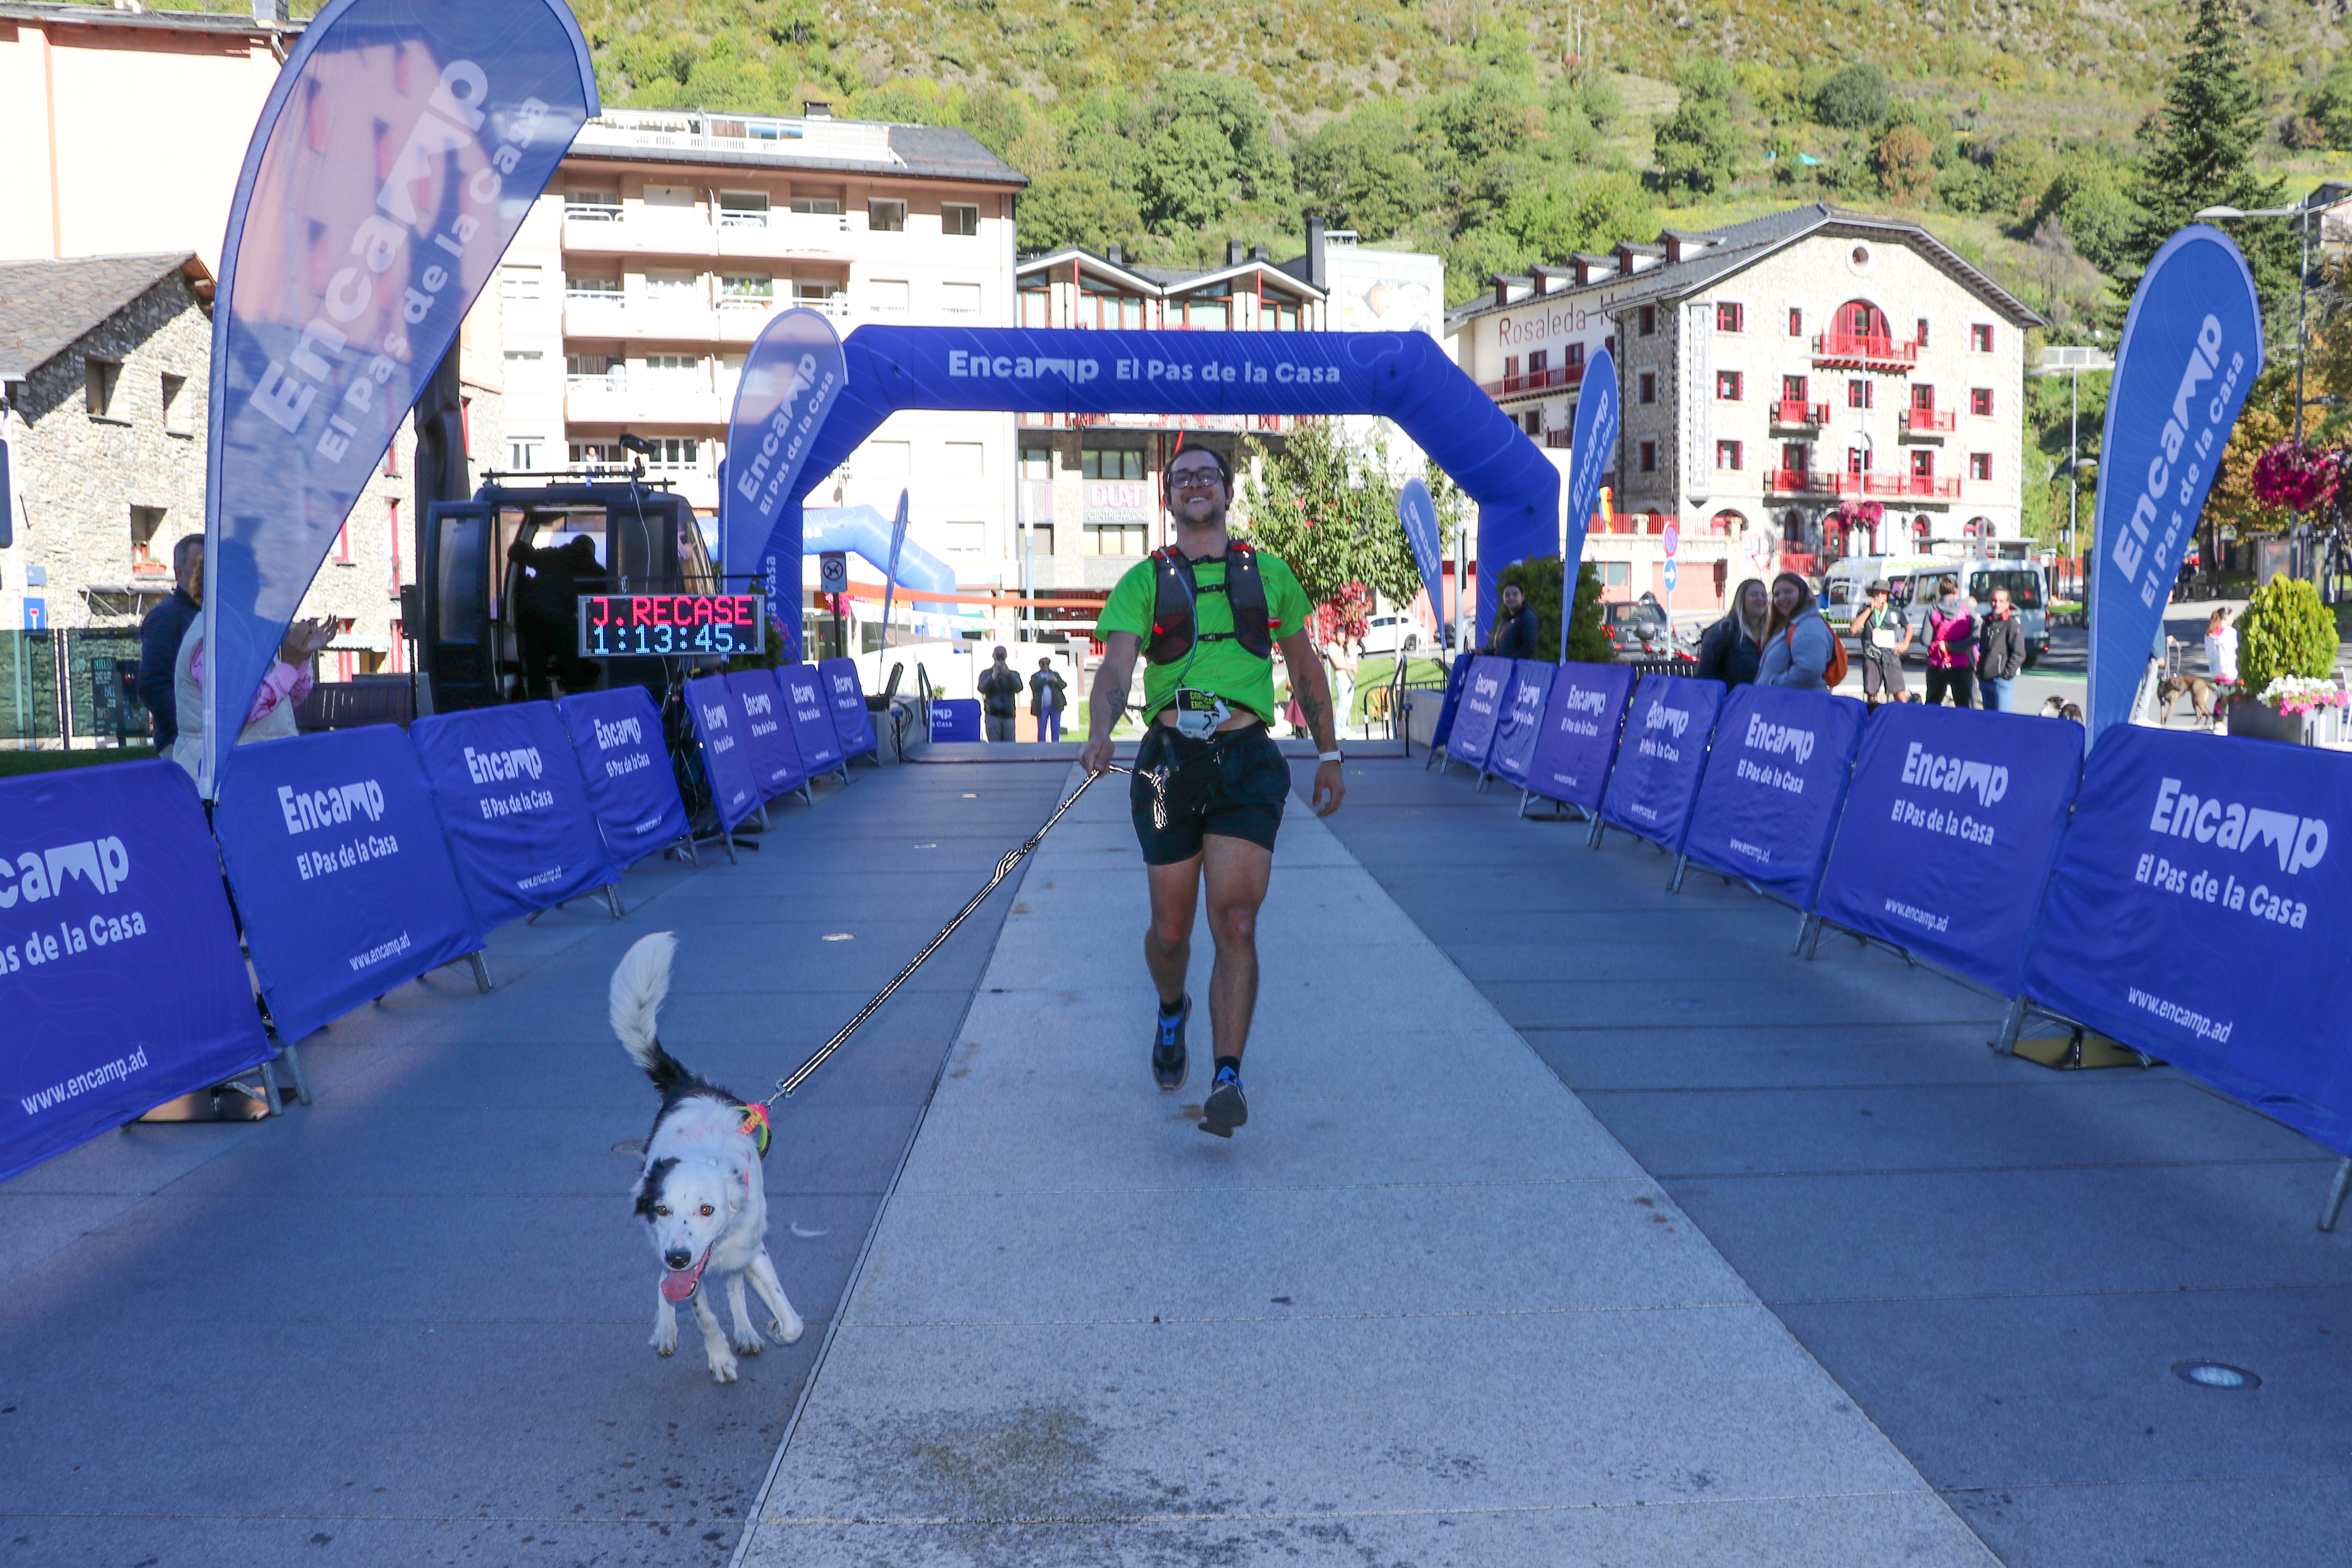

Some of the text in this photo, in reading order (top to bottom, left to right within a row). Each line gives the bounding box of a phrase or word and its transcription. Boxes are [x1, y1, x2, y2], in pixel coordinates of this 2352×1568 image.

[249, 59, 487, 433] Encamp
[315, 97, 549, 464] El Pas de la Casa
[1499, 300, 1586, 347] Rosaleda
[949, 350, 1340, 384] Encamp El Pas de la Casa
[1694, 310, 1705, 483] HOTEL ROSALEDA
[737, 353, 816, 503] Encamp
[759, 371, 834, 516] El Pas de la Casa
[1573, 389, 1608, 514] Encamp
[2112, 314, 2222, 583] Encamp
[1584, 482, 1593, 512] Pas
[1603, 414, 1614, 447] Casa
[2141, 351, 2244, 609] El Pas de la Casa
[1088, 510, 1117, 521] CENTRE
[592, 595, 753, 626] J.RECASE
[742, 692, 771, 716] Encamp
[791, 683, 815, 704] Encamp
[1567, 684, 1606, 717] Encamp
[594, 716, 642, 750] Encamp
[1664, 743, 1680, 762] Casa
[1745, 712, 1814, 765] Encamp
[464, 746, 542, 784] Encamp
[605, 752, 650, 778] El Pas de la Casa
[1737, 758, 1804, 794] El Pas de la Casa
[1901, 741, 2008, 808] Encamp
[277, 779, 384, 835] Encamp
[480, 789, 553, 819] El Pas de la Casa
[1891, 799, 1994, 846] El Pas de la Casa
[2150, 776, 2328, 875] Encamp
[296, 835, 399, 880] El Pas de la Casa
[1885, 898, 1949, 932] www.encamp.ad
[2135, 853, 2307, 929] El Pas de la Casa
[25, 931, 59, 965] de
[61, 921, 88, 955] la
[90, 911, 147, 946] Casa
[349, 931, 411, 972] www.encamp.ad
[2128, 986, 2233, 1044] www.encamp.ad
[21, 1045, 148, 1115] www.encamp.ad
